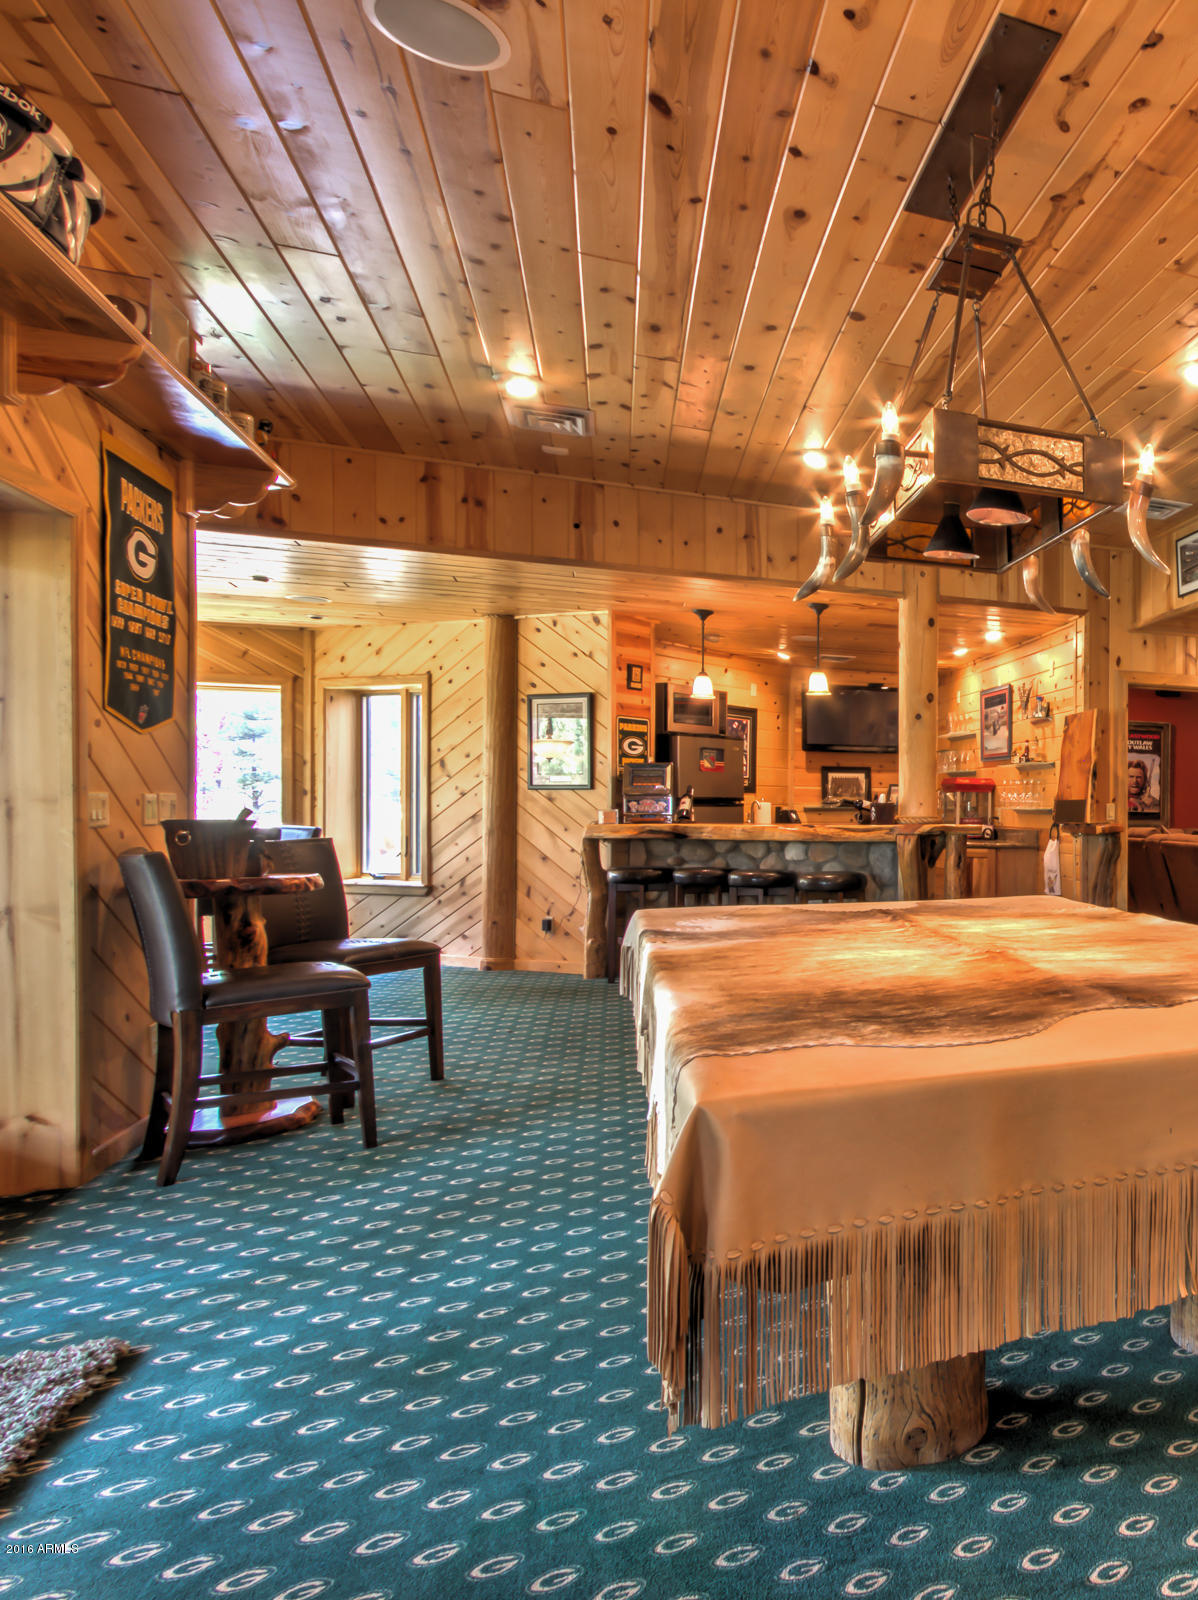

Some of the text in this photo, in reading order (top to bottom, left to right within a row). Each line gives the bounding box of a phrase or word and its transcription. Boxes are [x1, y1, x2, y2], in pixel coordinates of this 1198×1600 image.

[120, 476, 165, 535] PACKERS
[127, 528, 157, 581] G
[623, 736, 644, 755] G
